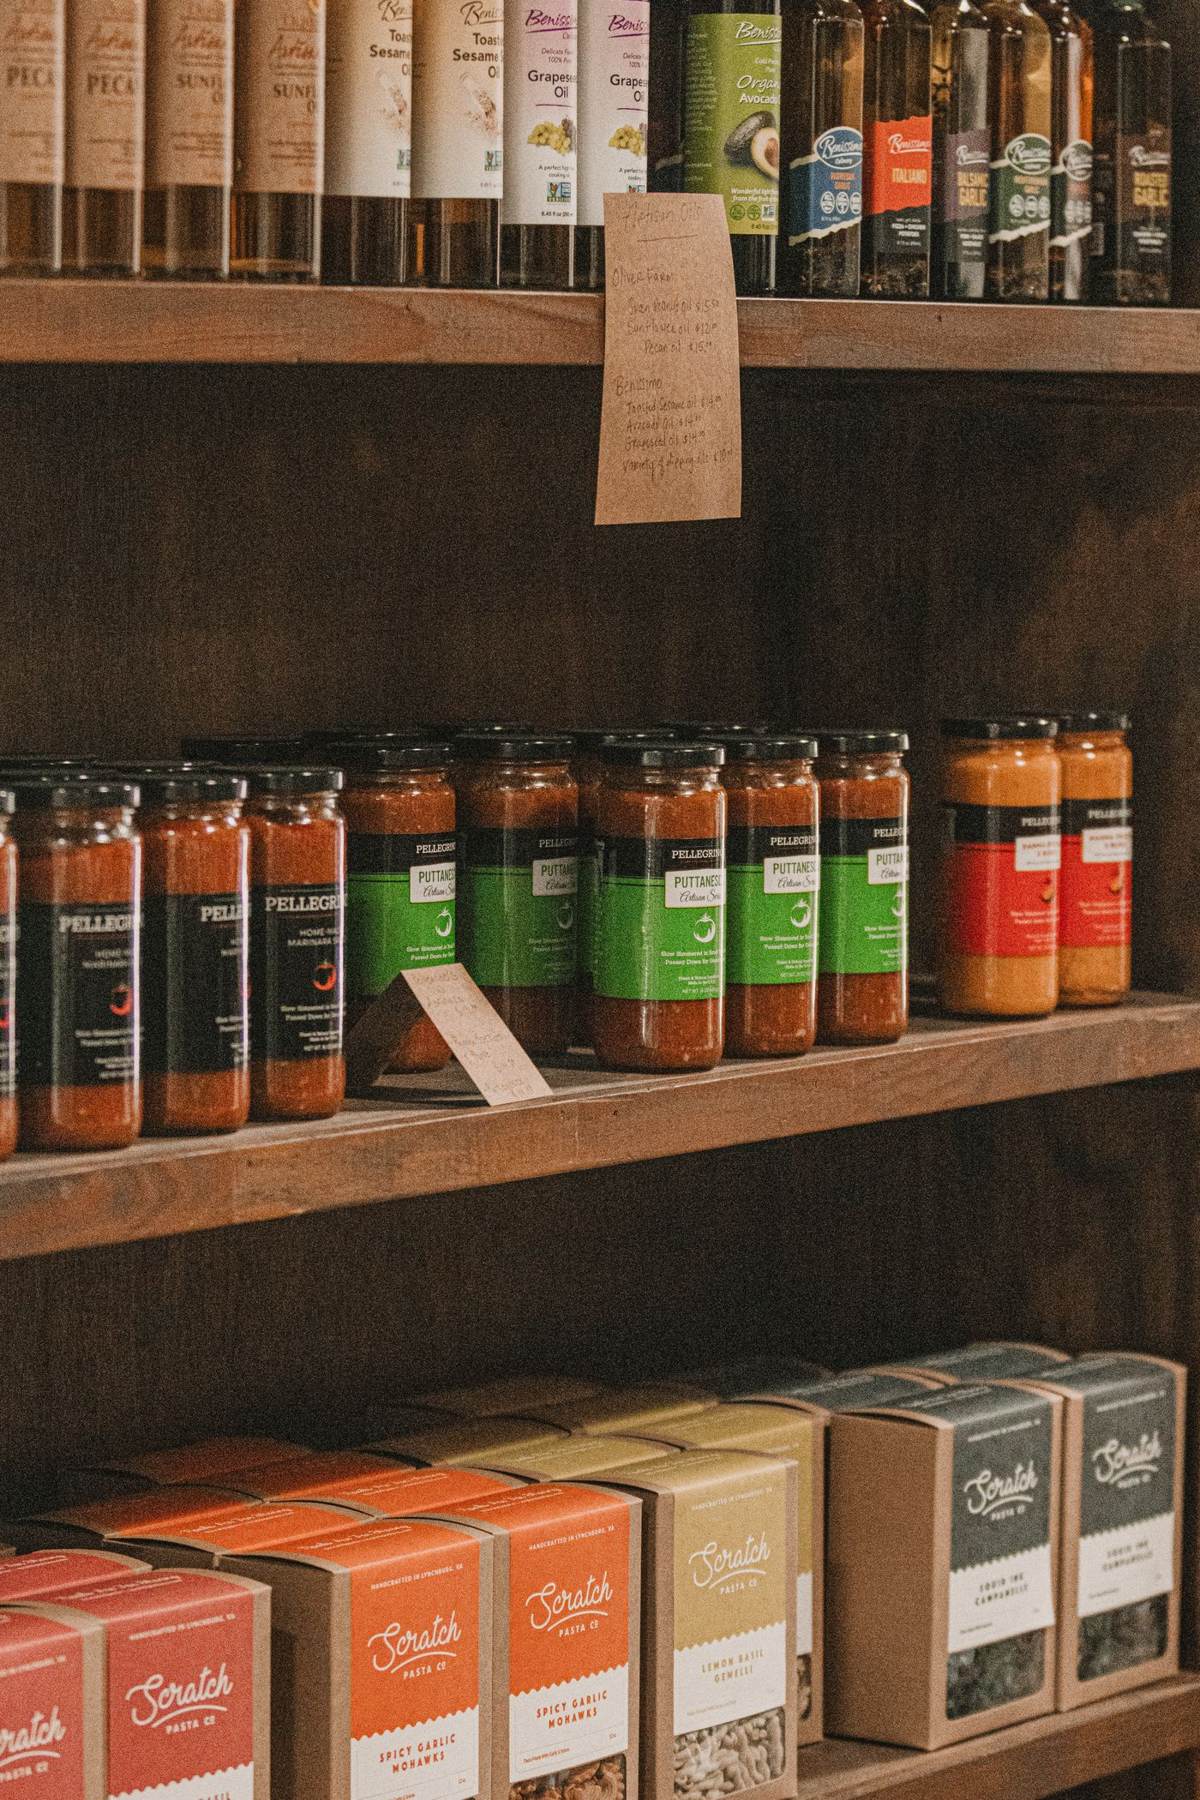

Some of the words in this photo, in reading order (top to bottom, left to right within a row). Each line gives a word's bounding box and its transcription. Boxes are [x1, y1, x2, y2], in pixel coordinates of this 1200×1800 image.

[554, 86, 569, 99] Oil
[963, 1459, 1039, 1514] Scratch
[688, 1530, 771, 1588] Scratch
[525, 1570, 614, 1630] Scratch
[719, 1582, 746, 1595] PASTA
[367, 1610, 462, 1672] Scratch
[559, 1623, 586, 1638] PASTA
[403, 1662, 433, 1680] PASTA
[701, 1657, 734, 1673] LEMON
[738, 1648, 765, 1664] BASIL
[714, 1664, 753, 1684] GEMELLI
[125, 1662, 234, 1727] Scratch
[535, 1702, 568, 1719] SPICY
[572, 1690, 608, 1709] GARLIC
[165, 1719, 200, 1735] PASTA
[548, 1706, 598, 1729] MOHAWKS
[379, 1745, 412, 1763] SPICY
[417, 1733, 456, 1753] GARLIC
[392, 1750, 445, 1774] MOHAWKS
